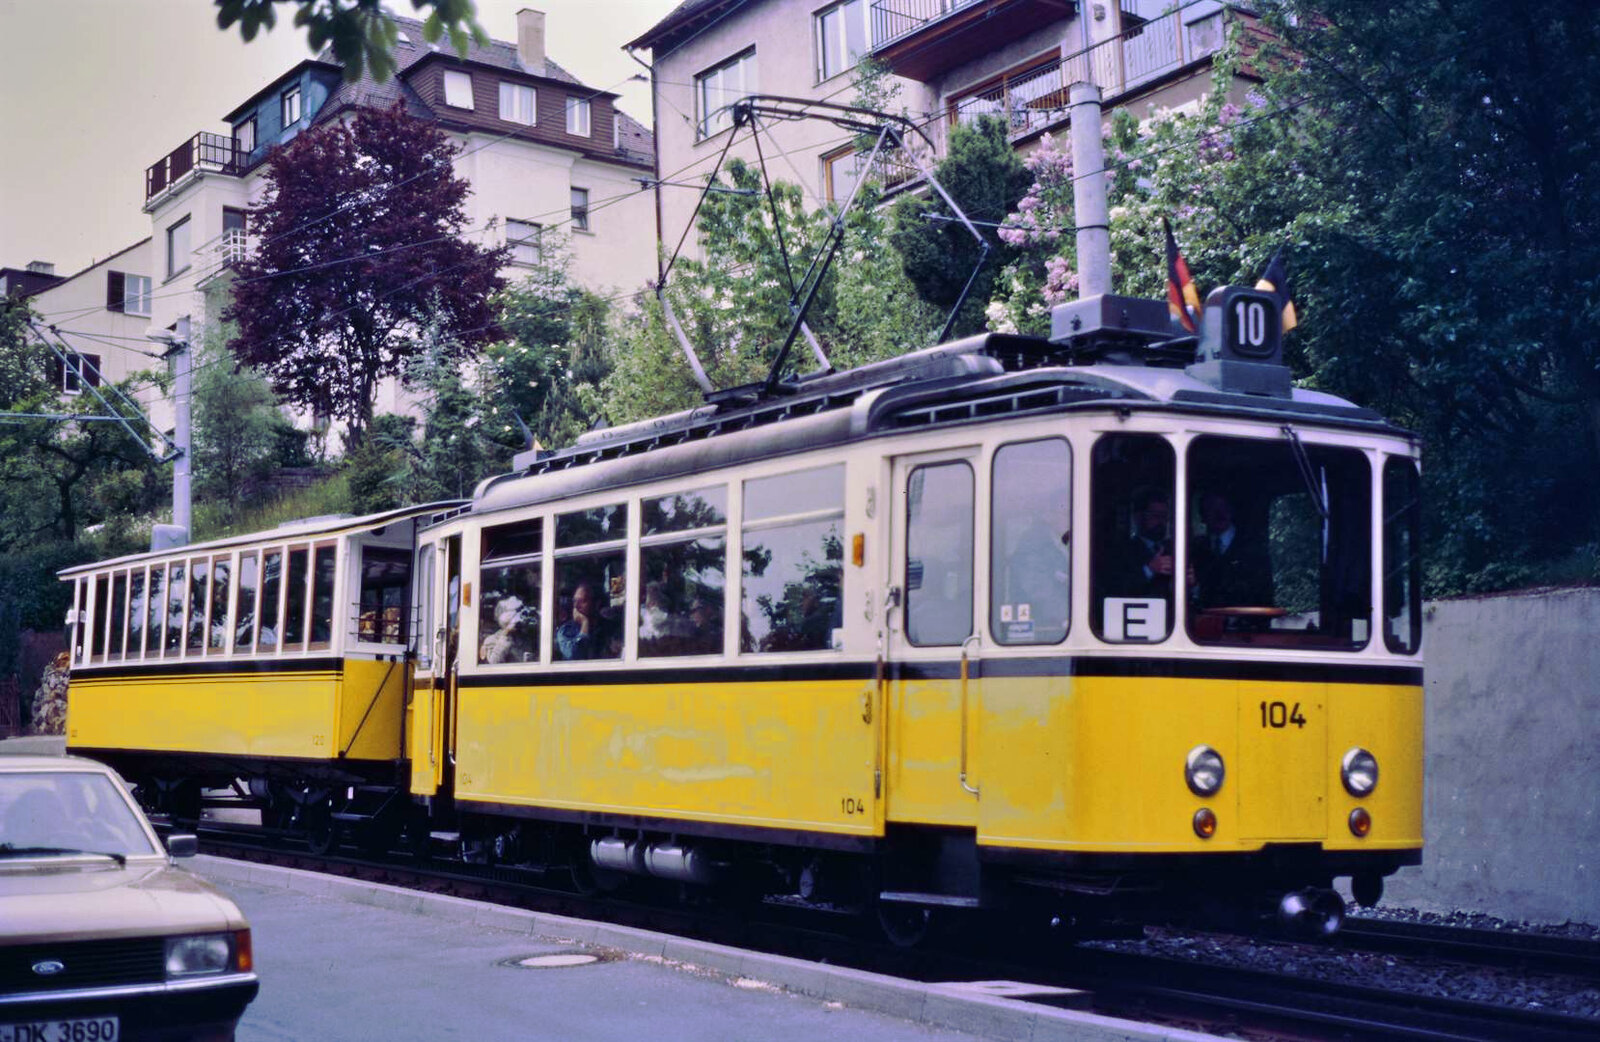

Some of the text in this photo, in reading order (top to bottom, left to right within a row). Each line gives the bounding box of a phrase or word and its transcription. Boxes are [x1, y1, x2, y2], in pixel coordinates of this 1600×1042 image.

[1236, 301, 1265, 346] 10
[1123, 603, 1149, 640] E
[1260, 701, 1307, 729] 104
[841, 798, 865, 815] 104
[0, 1020, 115, 1042] -DK 3690
